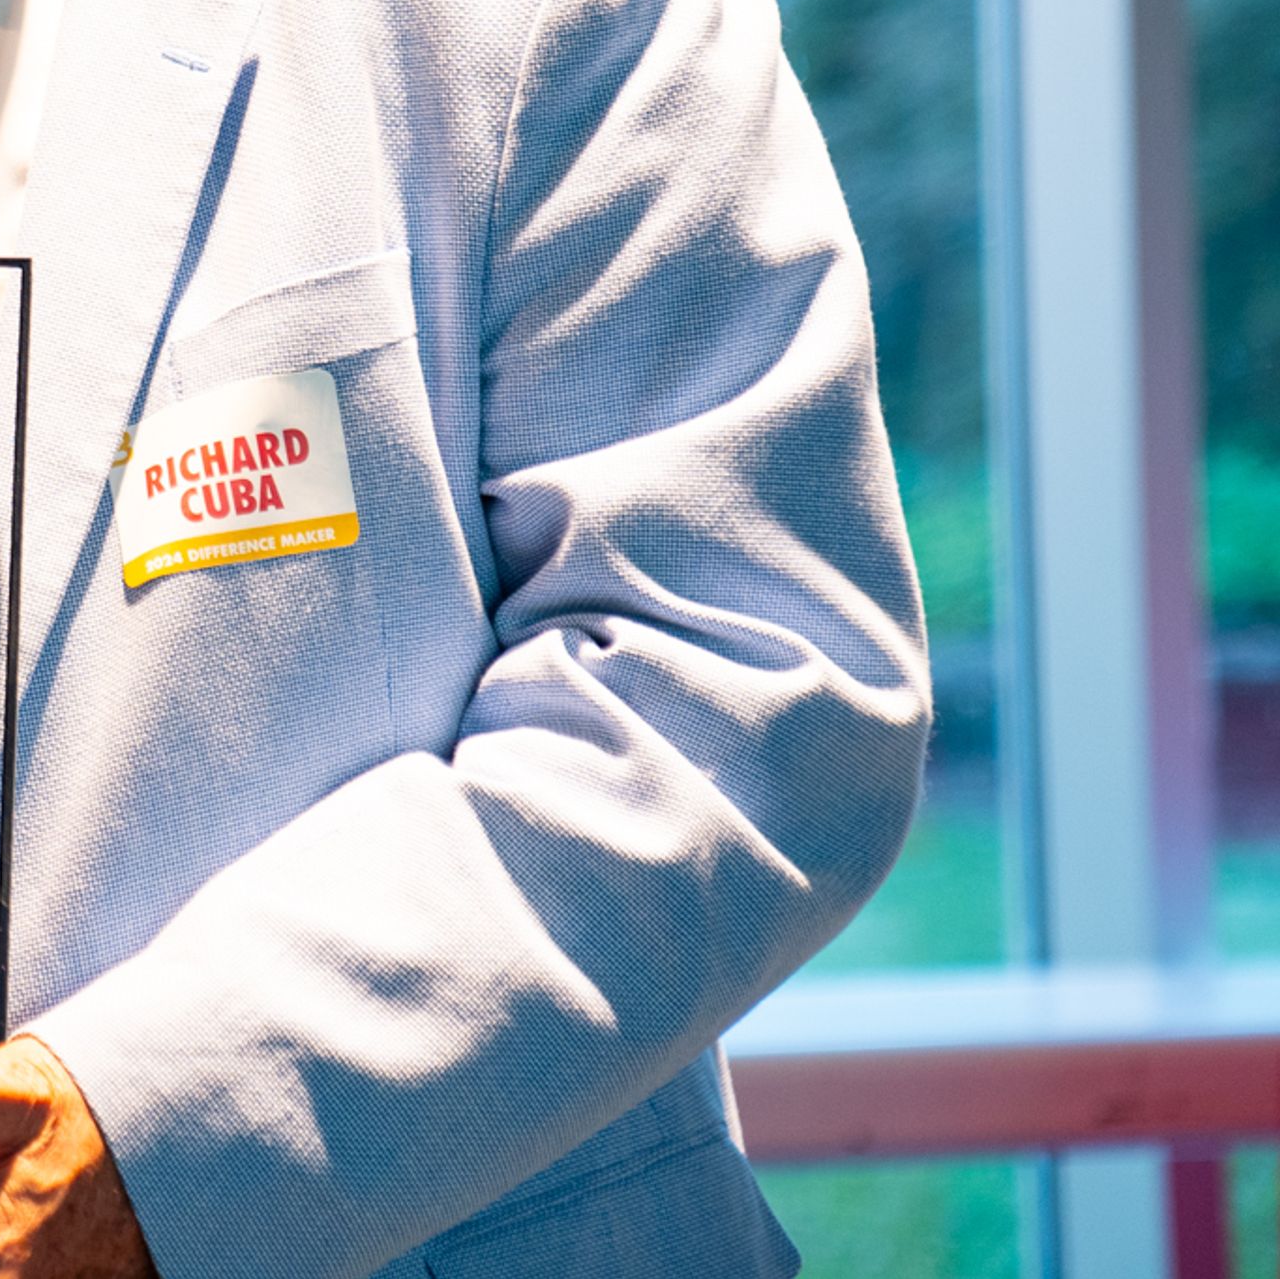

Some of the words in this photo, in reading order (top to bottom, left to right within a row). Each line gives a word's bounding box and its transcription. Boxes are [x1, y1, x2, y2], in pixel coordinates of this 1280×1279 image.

[144, 427, 310, 500] RICHARD
[180, 473, 285, 523] CUBA
[144, 551, 184, 574] 2024
[186, 536, 277, 563] DIFFERENCE
[280, 527, 337, 549] MAKER
